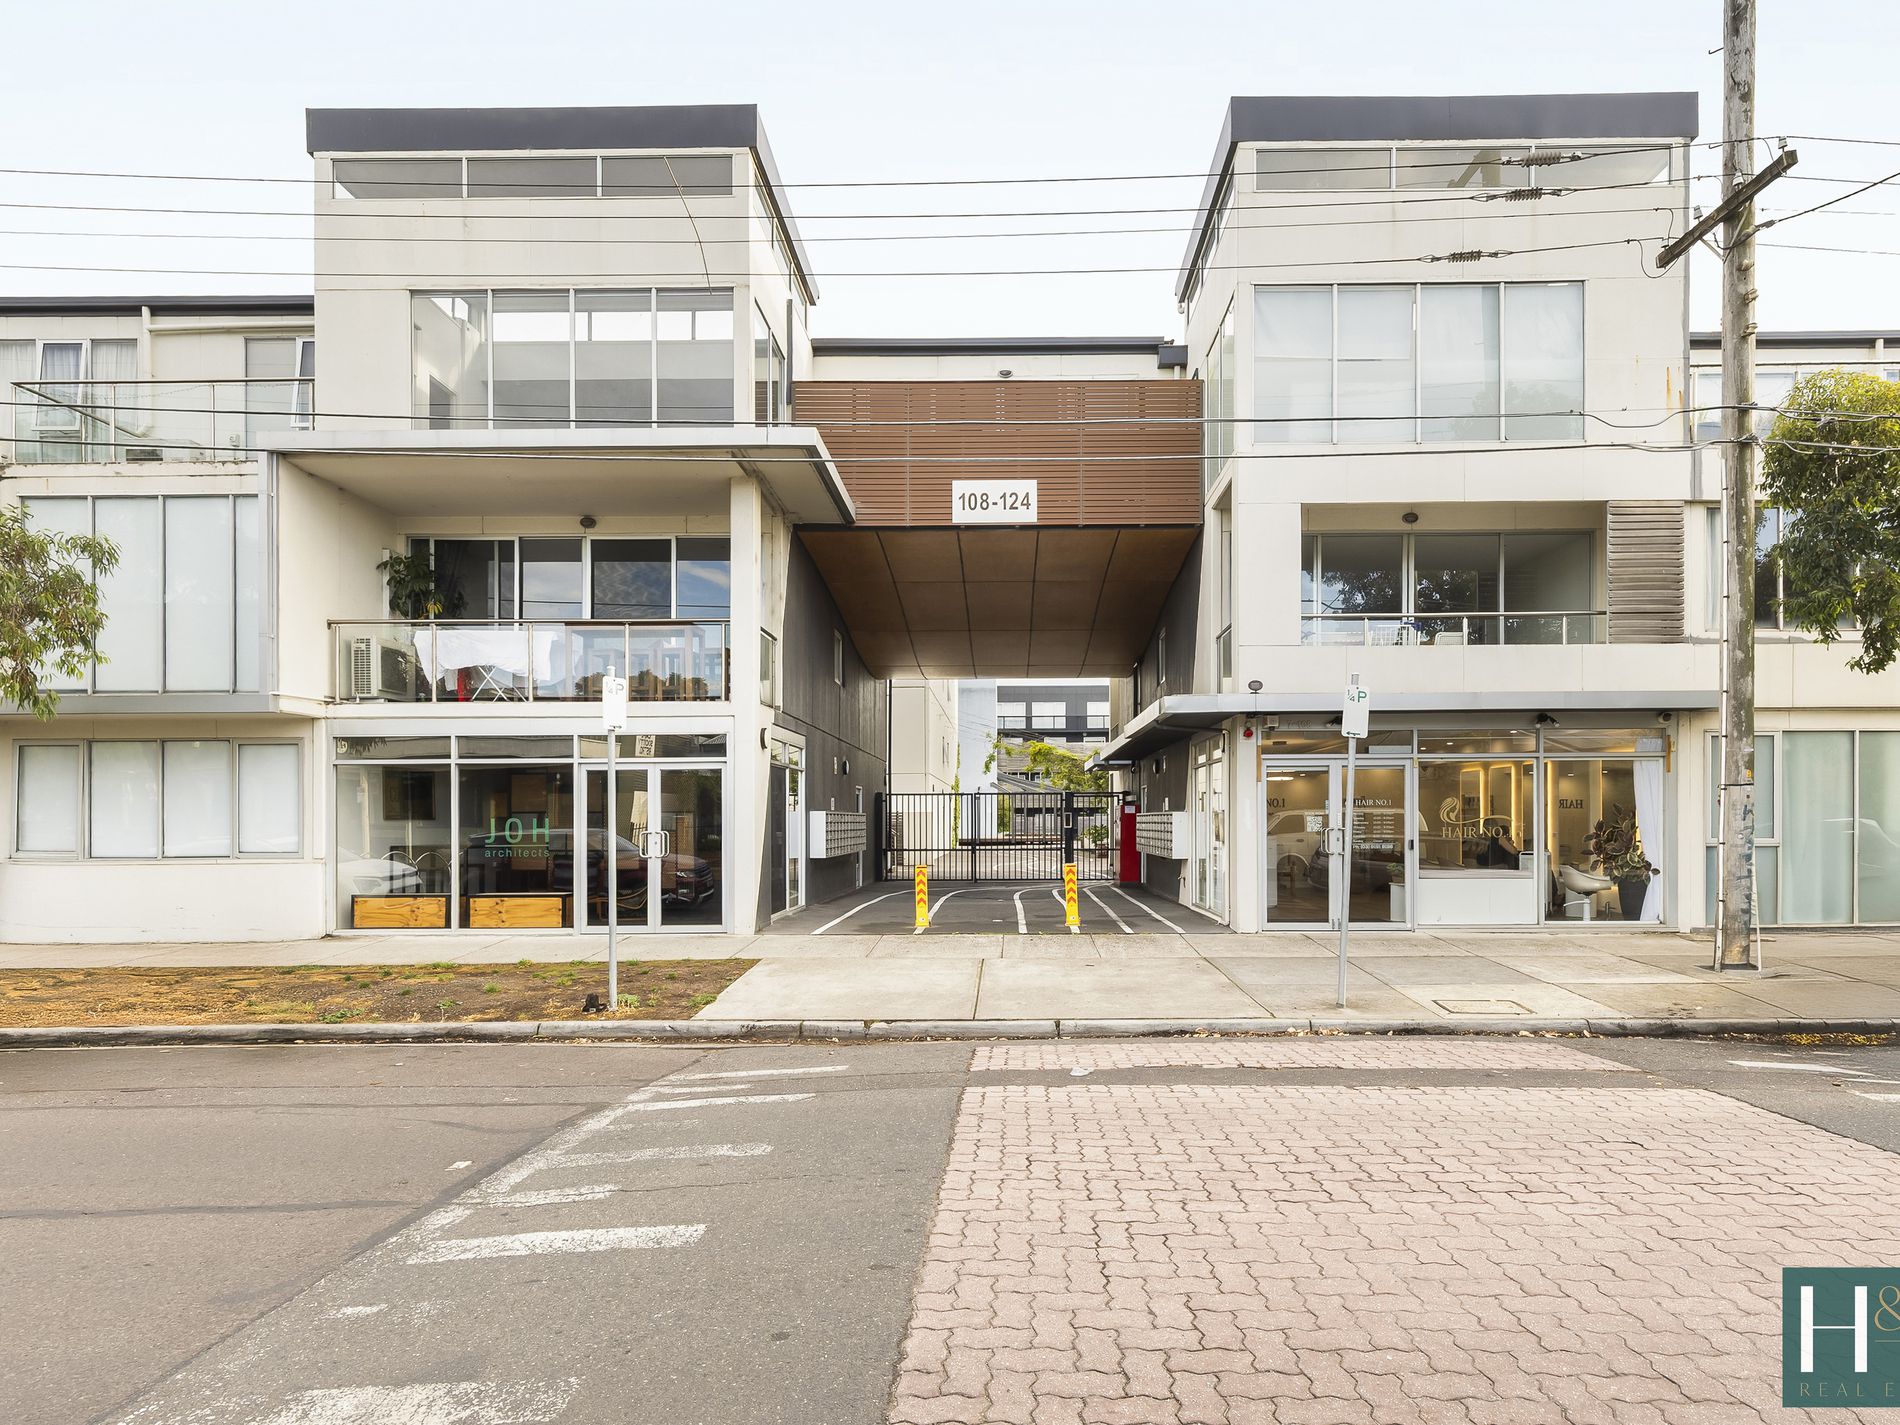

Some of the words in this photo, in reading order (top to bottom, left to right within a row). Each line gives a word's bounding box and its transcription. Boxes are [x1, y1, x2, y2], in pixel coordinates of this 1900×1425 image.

[958, 492, 1031, 511] 108-124
[484, 817, 550, 844] JOH
[1442, 826, 1477, 838] HAIR
[484, 848, 550, 858] architects
